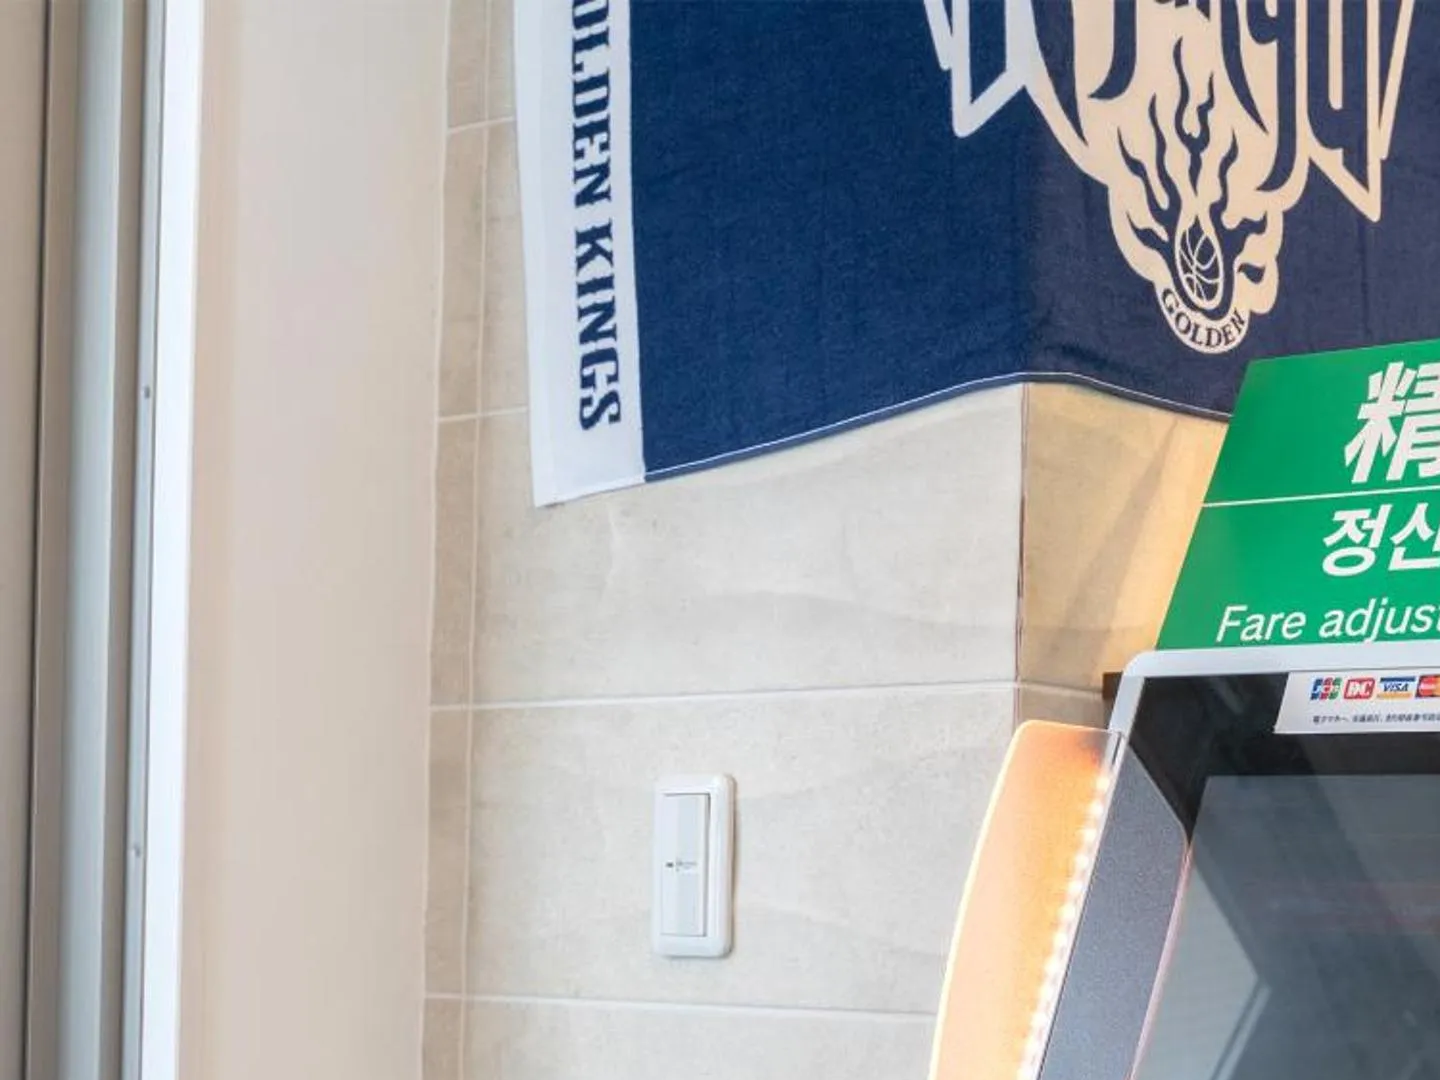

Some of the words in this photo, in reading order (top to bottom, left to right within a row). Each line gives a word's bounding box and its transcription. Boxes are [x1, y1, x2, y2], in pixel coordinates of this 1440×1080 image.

[576, 218, 623, 433] KINGS
[1161, 287, 1245, 348] GOLDEN
[1216, 602, 1307, 644] Fare
[1382, 682, 1411, 693] VISA
